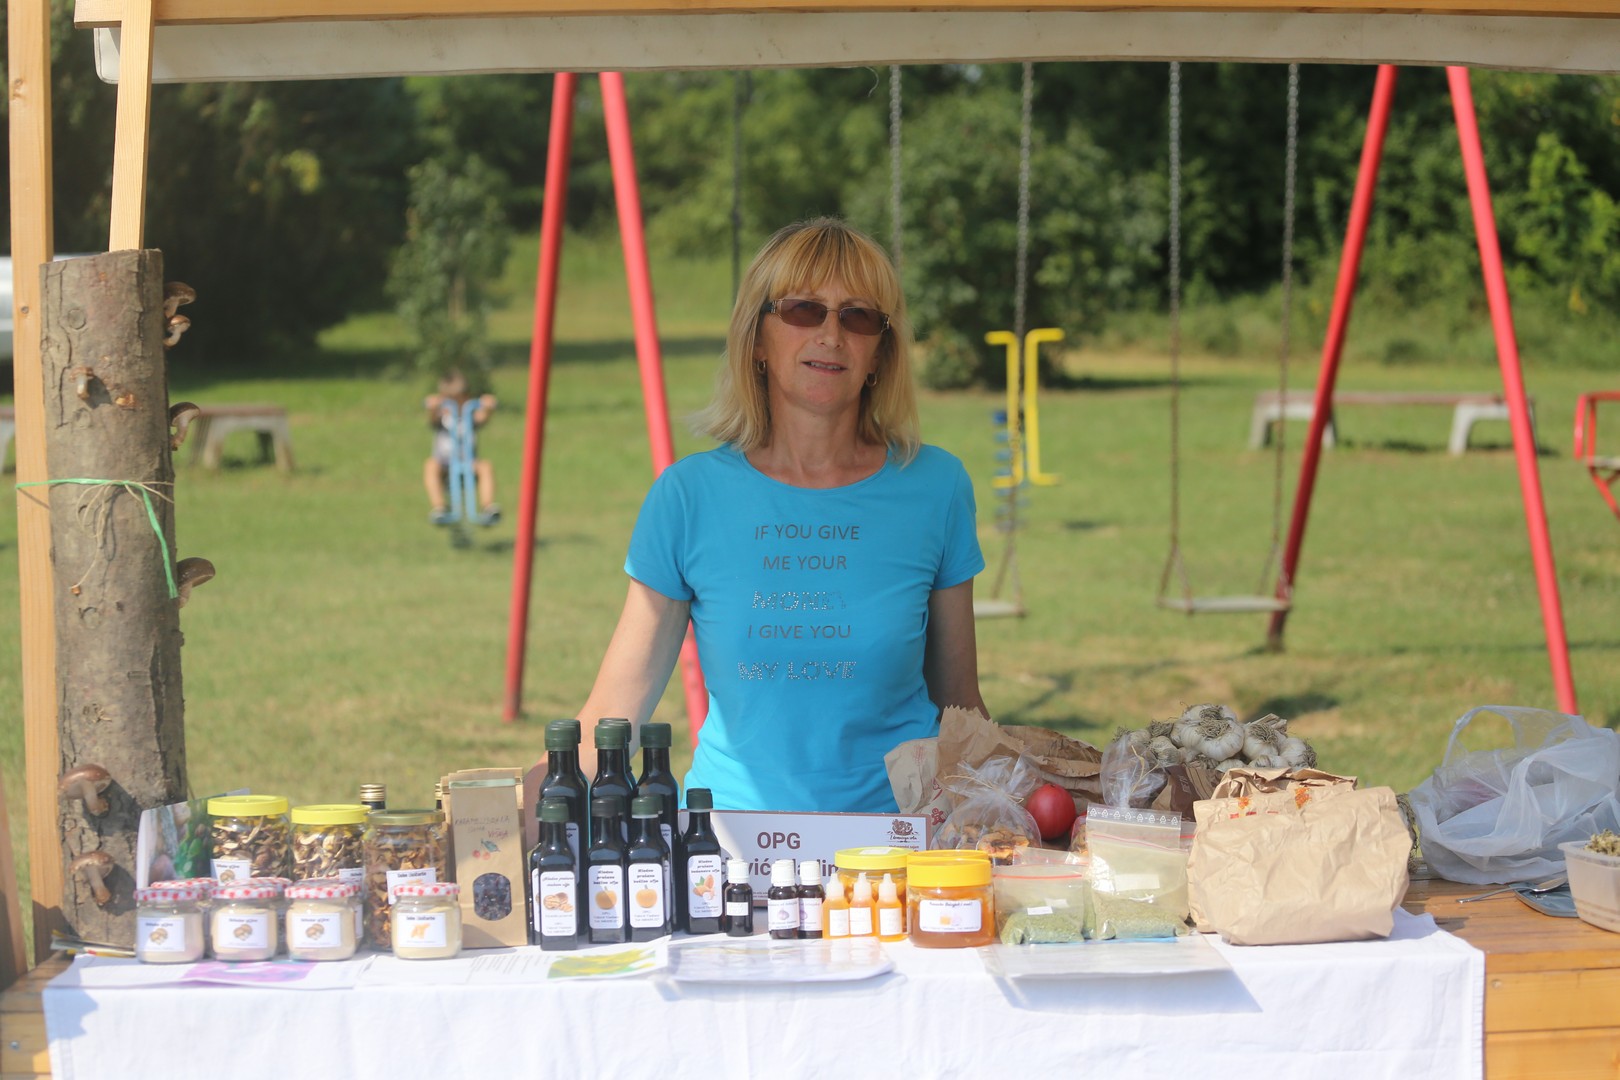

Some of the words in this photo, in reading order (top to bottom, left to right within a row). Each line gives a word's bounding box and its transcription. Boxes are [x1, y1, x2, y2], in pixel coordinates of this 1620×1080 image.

[755, 525, 769, 540] IF
[775, 524, 812, 539] YOU
[818, 525, 861, 540] GIVE
[763, 556, 791, 570] ME
[797, 555, 847, 570] YOUR
[748, 624, 753, 639] I
[759, 624, 804, 639] GIVE
[810, 624, 852, 639] YOU
[737, 662, 780, 680] MY
[787, 661, 857, 680] LOVE
[757, 831, 801, 850] OPG
